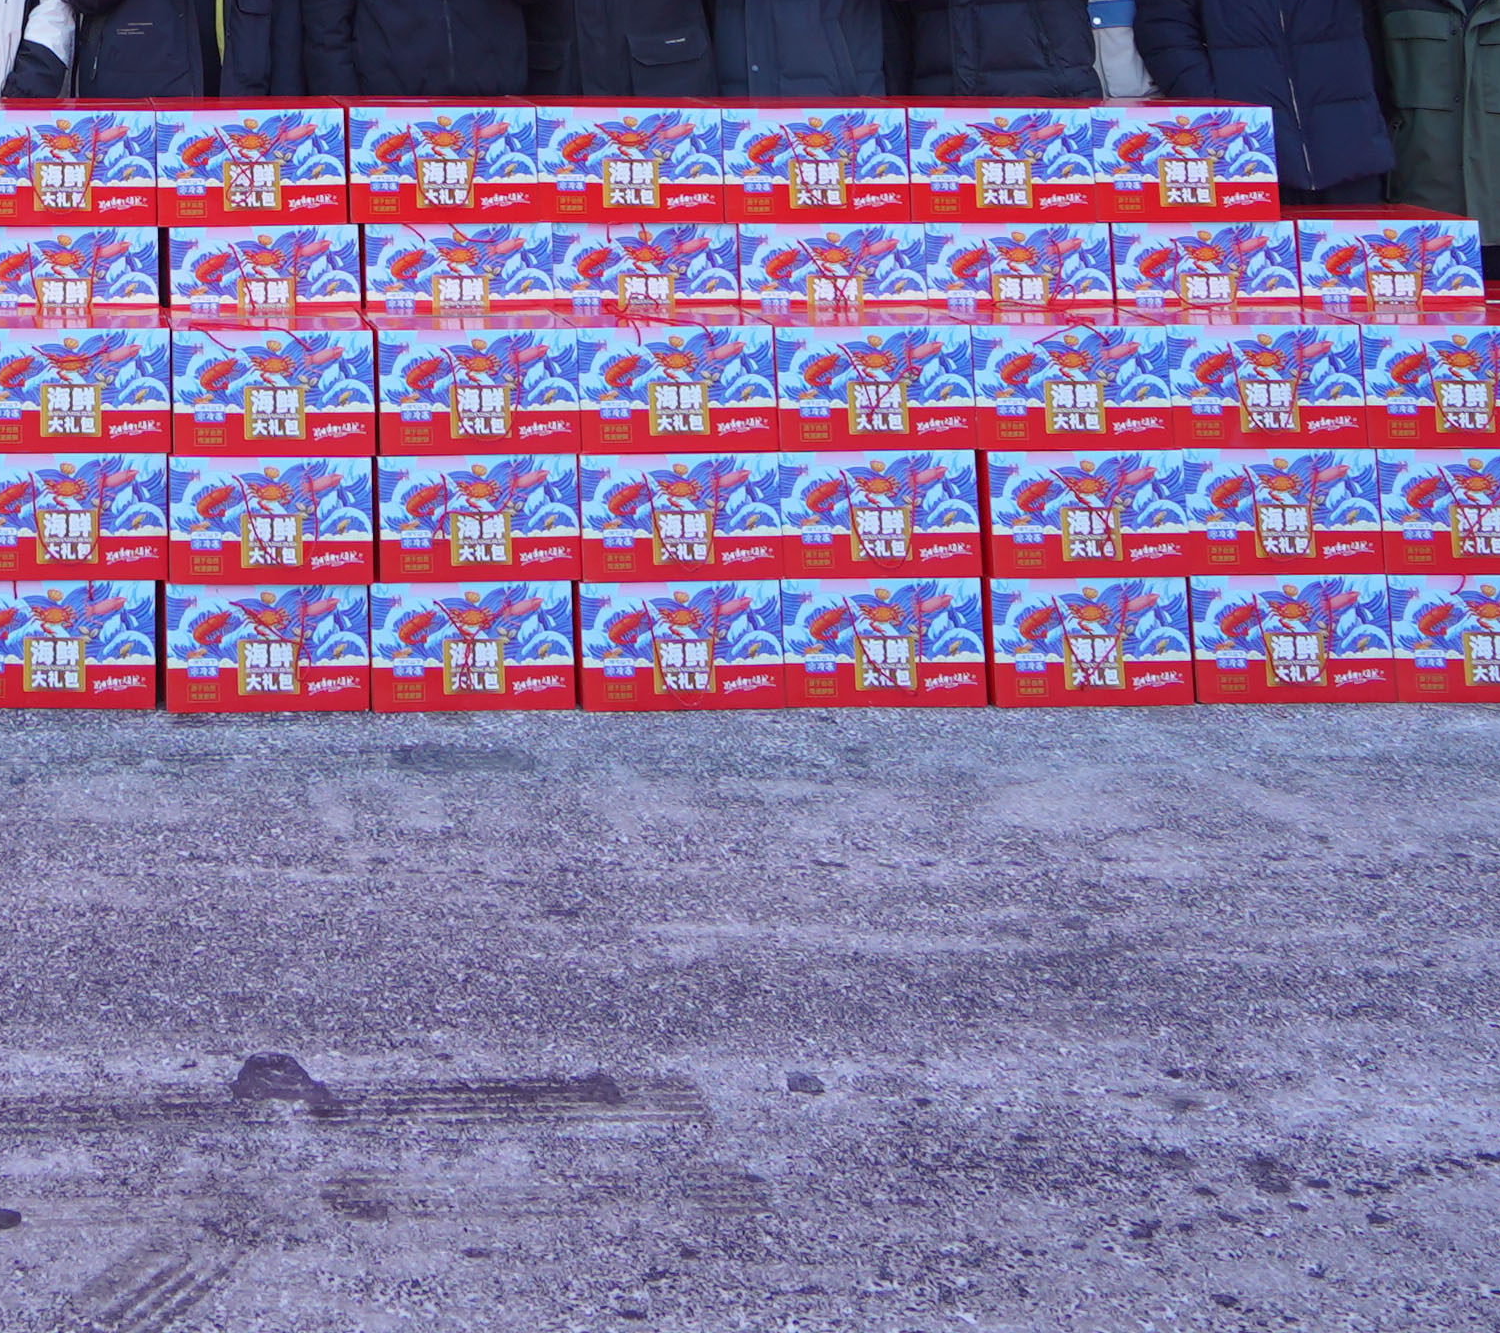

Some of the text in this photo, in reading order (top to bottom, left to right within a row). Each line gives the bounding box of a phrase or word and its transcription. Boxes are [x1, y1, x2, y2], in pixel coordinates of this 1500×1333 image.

[423, 162, 468, 183] 海鲜
[610, 162, 654, 183] 海鲜
[981, 163, 1026, 184] 海鲜
[1164, 161, 1209, 182] 海鲜
[423, 188, 468, 203] 大礼包
[611, 188, 653, 203] 大礼包
[983, 189, 1027, 204] 大礼包
[1166, 187, 1210, 202] 大礼包
[47, 387, 94, 411] 海鲜
[251, 389, 298, 413] 海鲜
[654, 385, 702, 409] 海鲜
[1050, 384, 1098, 408] 海鲜
[1245, 383, 1292, 406] 海鲜
[1441, 383, 1488, 406] 海鲜
[48, 416, 94, 433] 大礼包
[252, 418, 298, 435] 大礼包
[656, 414, 703, 431] 大礼包
[1052, 413, 1099, 430] 大礼包
[1247, 412, 1293, 428] 大礼包
[1443, 412, 1489, 428] 大礼包
[44, 513, 91, 537] 海鲜
[457, 515, 505, 539] 海鲜
[856, 510, 904, 534] 海鲜
[1261, 507, 1307, 531] 海鲜
[45, 542, 91, 559] 大礼包
[459, 544, 506, 561] 大礼包
[858, 539, 905, 556] 大礼包
[1263, 536, 1308, 553] 大礼包
[31, 641, 78, 665] 海鲜
[245, 643, 292, 668] 海鲜
[660, 643, 708, 667] 海鲜
[32, 670, 78, 687] 大礼包
[246, 673, 292, 690] 大礼包
[662, 672, 709, 689] 大礼包
